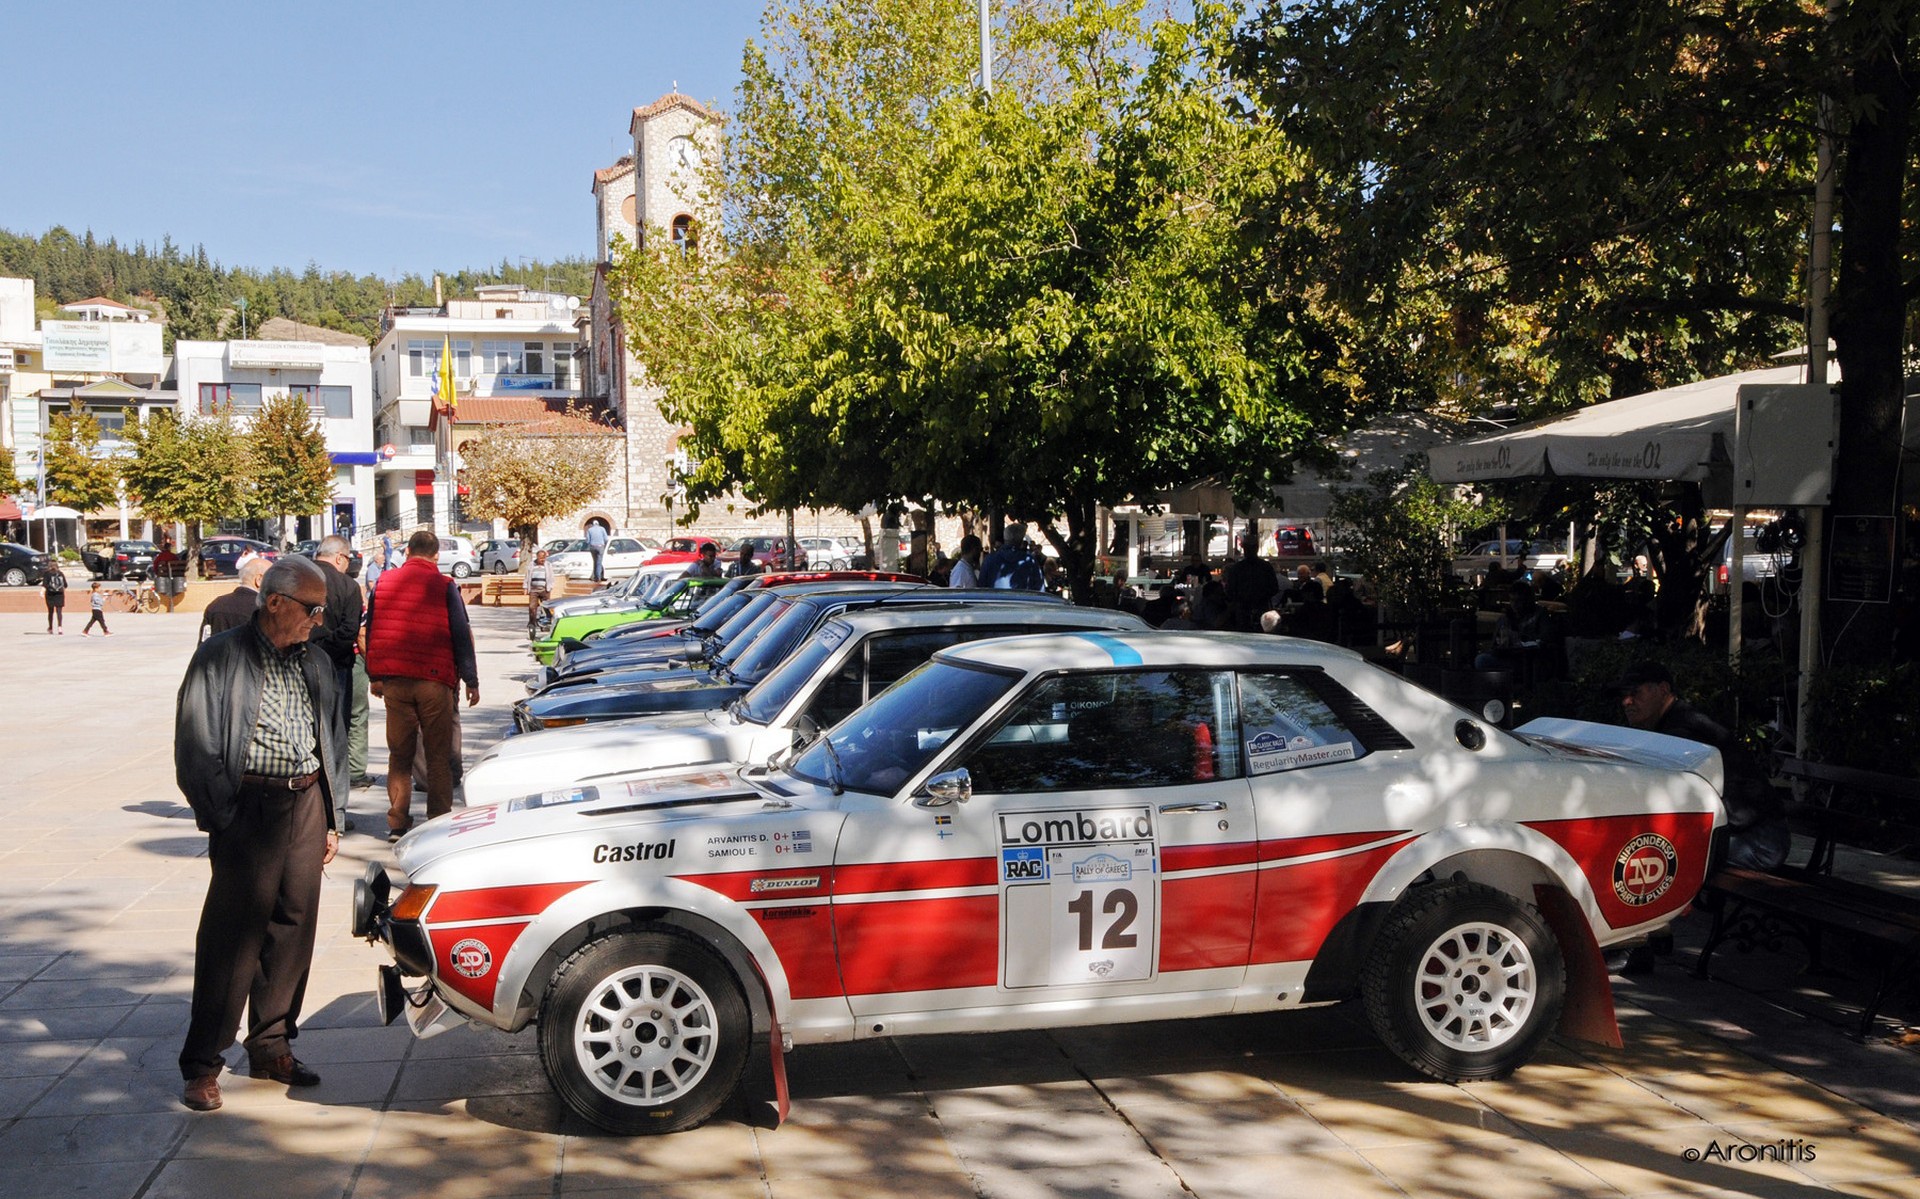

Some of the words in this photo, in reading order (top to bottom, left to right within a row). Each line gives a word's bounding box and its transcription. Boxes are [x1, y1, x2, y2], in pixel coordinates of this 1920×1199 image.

[1070, 701, 1109, 709] OIKONO
[1252, 747, 1352, 770] RegularityMaster.com
[999, 809, 1154, 844] Lombard
[593, 838, 676, 863] Castrol
[707, 834, 757, 845] ARVANITIS
[759, 834, 769, 842] D.
[1617, 836, 1675, 865] NIPPONDENSO
[708, 848, 746, 858] SAMIOU
[748, 847, 758, 856] E.
[1006, 860, 1043, 878] RAC
[1075, 865, 1093, 876] RALLY
[1095, 866, 1105, 874] OF
[1105, 863, 1128, 874] GREECE
[1628, 856, 1665, 886] ND
[766, 879, 817, 888] DUNLOP
[1615, 880, 1637, 904] SPARK
[1646, 874, 1674, 903] PLUGS
[1068, 888, 1139, 951] 12
